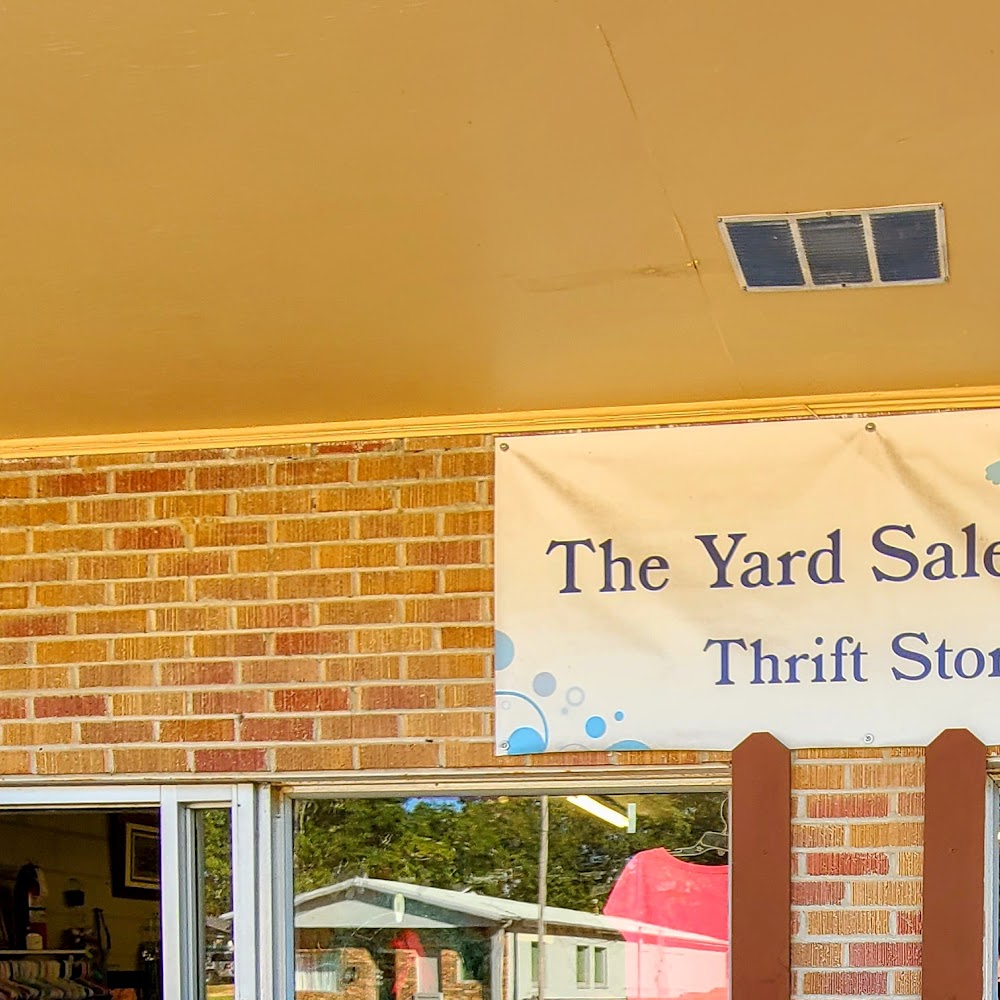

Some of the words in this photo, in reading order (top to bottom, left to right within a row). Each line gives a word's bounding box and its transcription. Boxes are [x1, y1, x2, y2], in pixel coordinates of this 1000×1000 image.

[546, 538, 670, 595] The
[694, 528, 844, 589] Yard
[704, 634, 869, 687] Thrift
